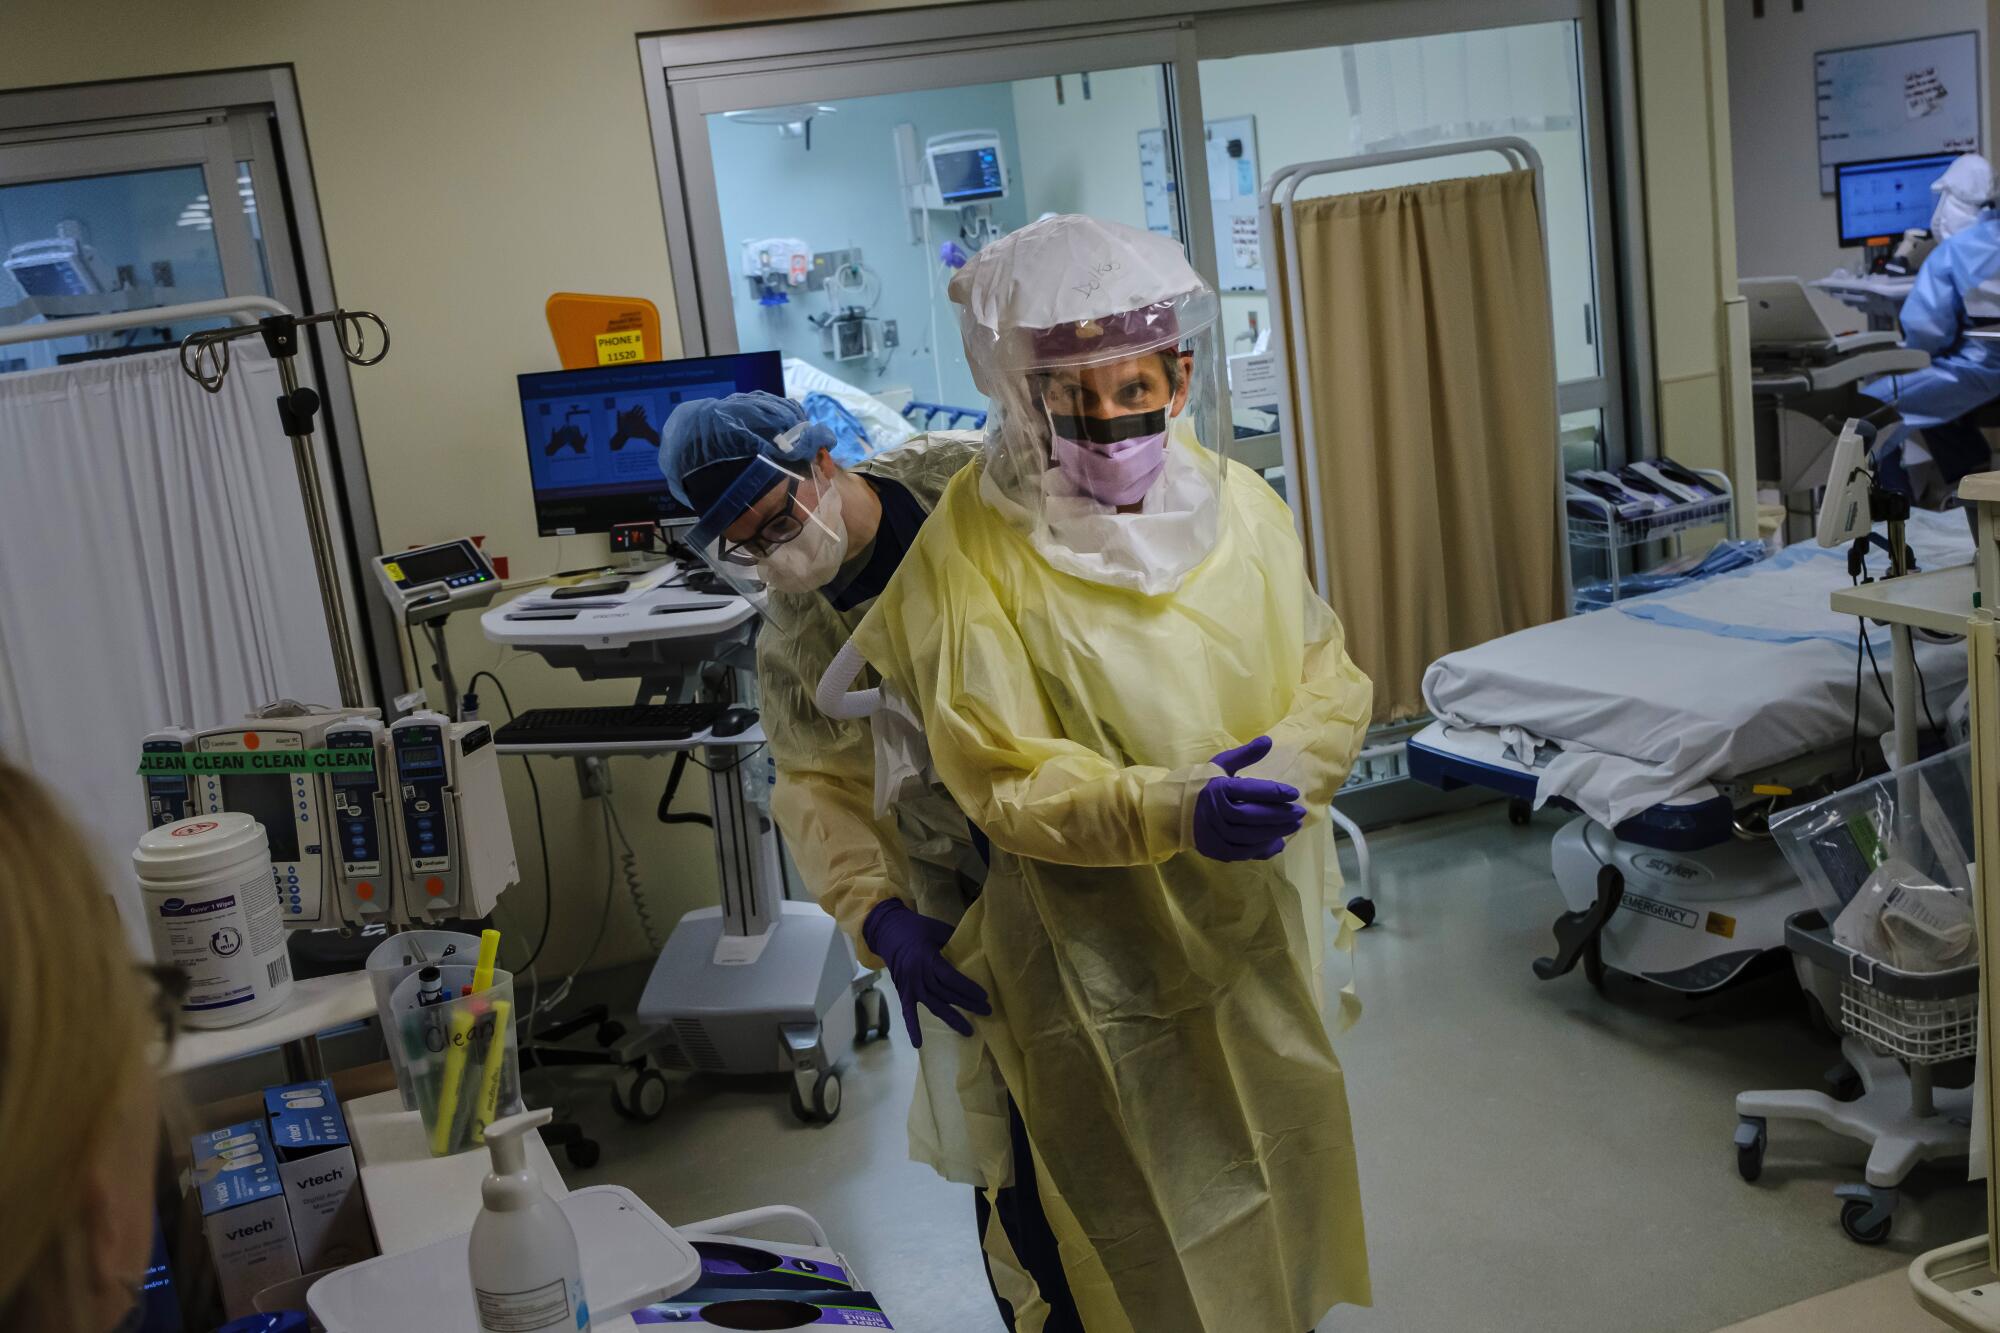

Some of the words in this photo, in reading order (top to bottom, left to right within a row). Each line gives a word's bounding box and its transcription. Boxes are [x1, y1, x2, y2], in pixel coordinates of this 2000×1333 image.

[598, 335, 633, 348] PHONE
[607, 350, 637, 362] 11520
[139, 755, 186, 771] CLEAN
[193, 755, 244, 770] CLEAN
[252, 754, 306, 769] CLEAN
[314, 752, 371, 768] CLEAN
[1646, 858, 1699, 880] stryker
[1622, 894, 1688, 923] EMERGENCY
[220, 943, 235, 951] min
[222, 934, 229, 944] 1
[425, 1021, 495, 1053] Clean
[287, 1122, 300, 1143] vtech
[297, 1168, 343, 1190] vtech
[225, 1219, 274, 1241] vtech
[842, 1313, 884, 1323] NITRILE
[846, 1319, 887, 1328] PURPLE
